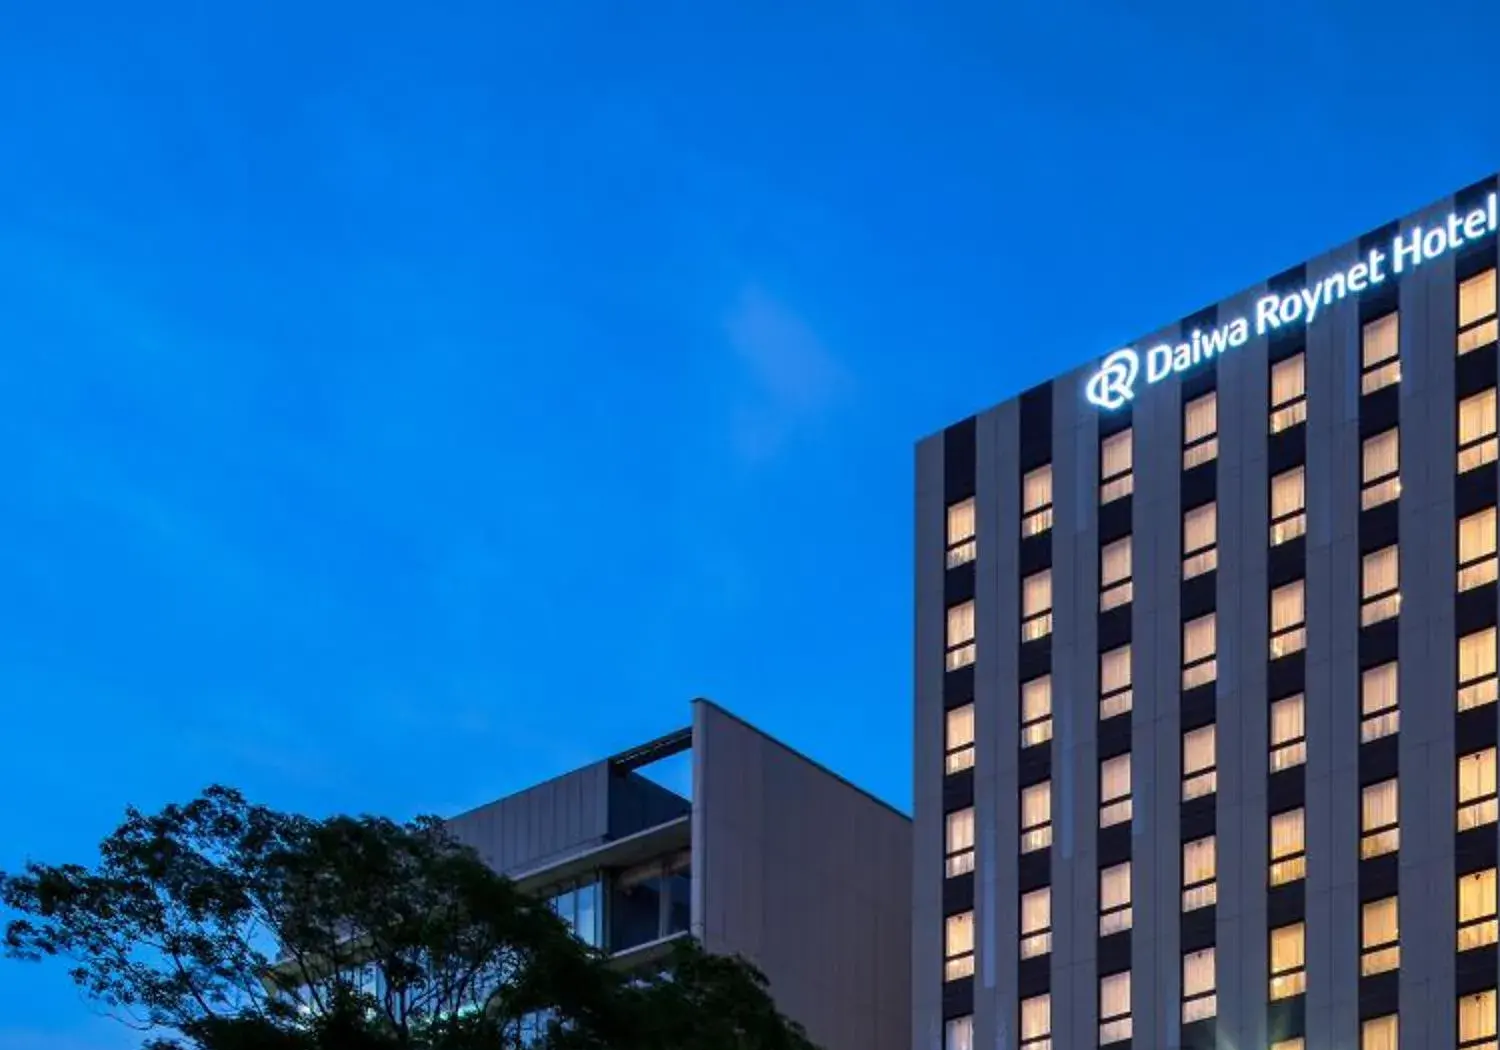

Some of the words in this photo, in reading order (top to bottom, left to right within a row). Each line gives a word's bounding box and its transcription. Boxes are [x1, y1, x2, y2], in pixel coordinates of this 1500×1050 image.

[1146, 316, 1247, 384] Daiwa
[1256, 248, 1386, 335] Roynet
[1393, 192, 1498, 274] Hotel
